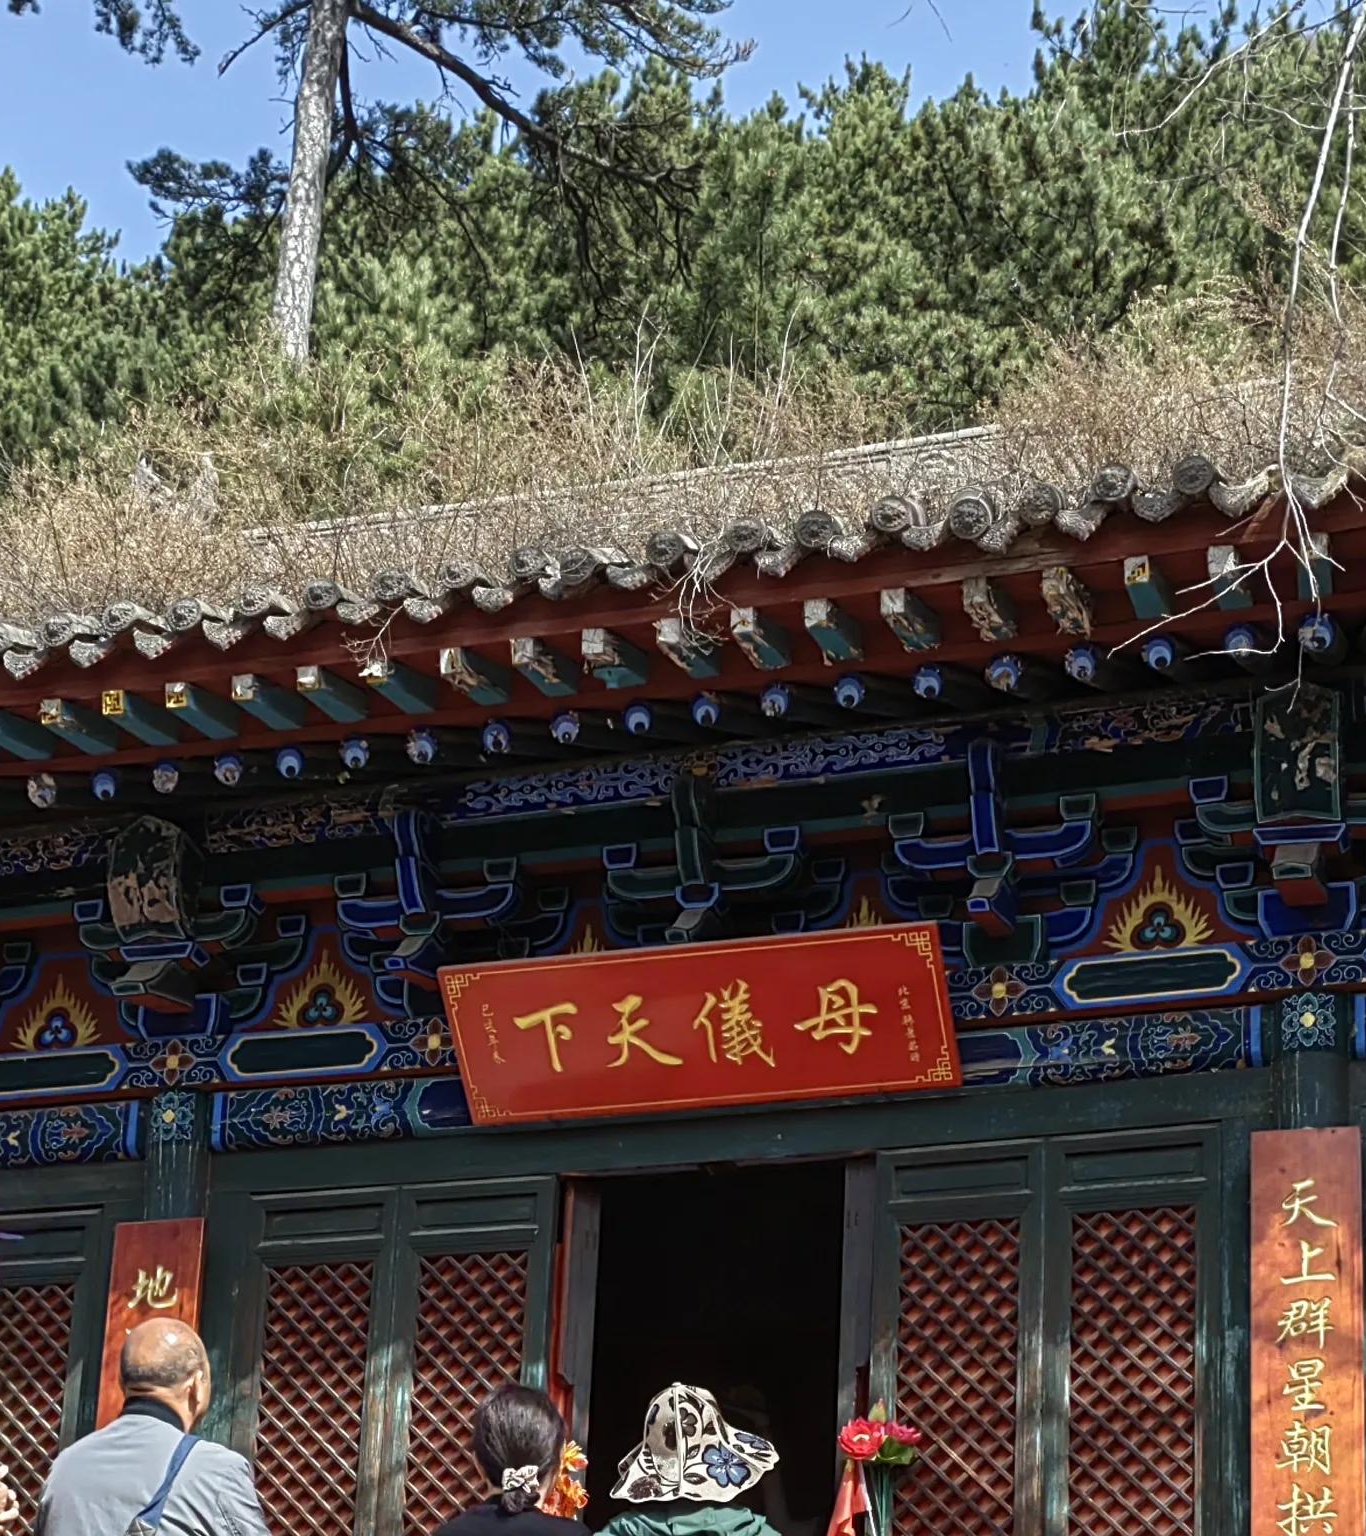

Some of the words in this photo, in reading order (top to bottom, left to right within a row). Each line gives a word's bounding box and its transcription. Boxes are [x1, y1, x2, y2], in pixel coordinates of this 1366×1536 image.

[514, 978, 879, 1072] 母儀天下
[128, 1264, 178, 1308] 地
